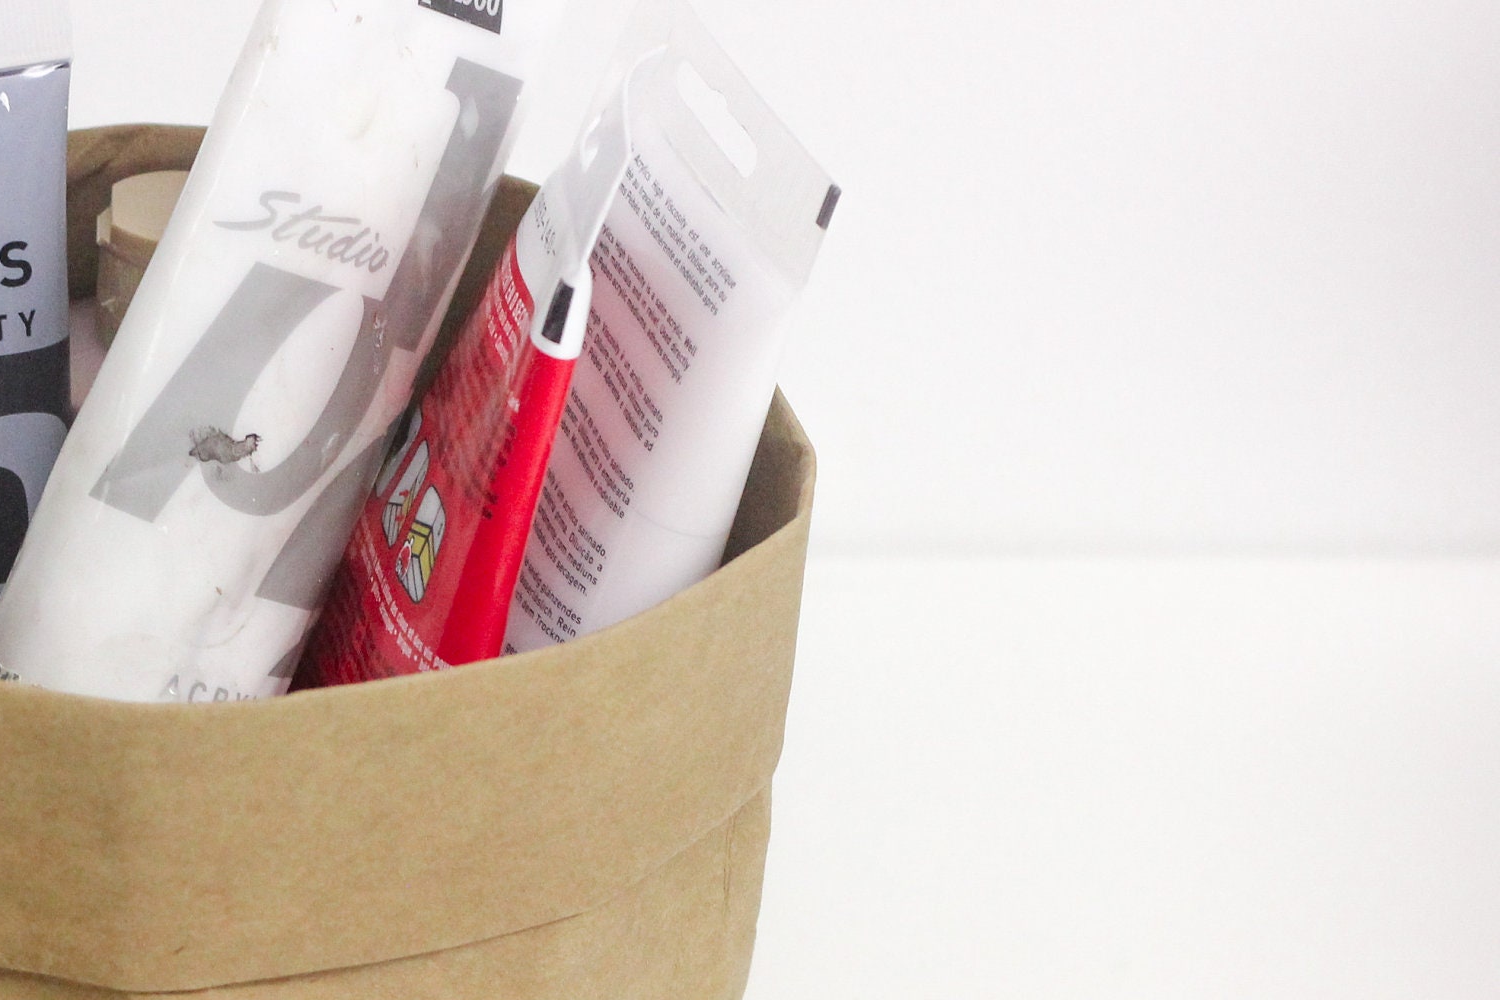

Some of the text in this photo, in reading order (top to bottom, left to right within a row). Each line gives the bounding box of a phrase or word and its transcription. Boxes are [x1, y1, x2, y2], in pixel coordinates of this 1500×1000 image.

[212, 190, 391, 274] Studio
[634, 154, 737, 290] Acrylics High Viscosity est une acrylique
[639, 187, 655, 211] travail
[687, 250, 708, 275] Utiliser
[705, 275, 720, 293] pure
[719, 291, 728, 303] ou
[578, 525, 607, 558] satinado.
[536, 614, 566, 645] Trockne
[557, 617, 577, 638] Rein
